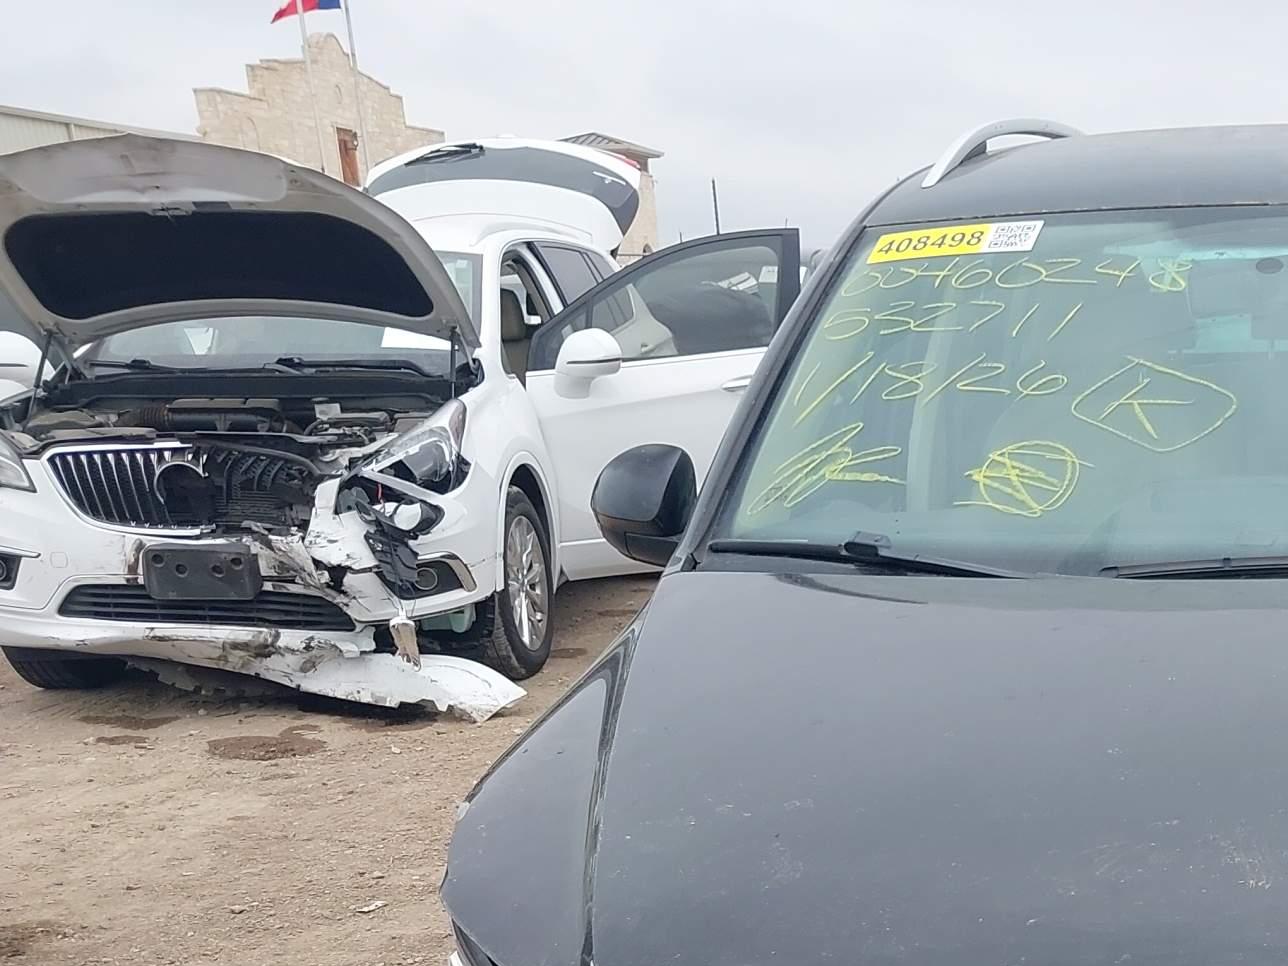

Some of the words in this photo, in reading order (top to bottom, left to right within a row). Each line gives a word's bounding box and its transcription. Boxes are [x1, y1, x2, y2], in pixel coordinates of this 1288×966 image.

[876, 229, 985, 257] 408498
[823, 300, 1084, 342] 532711
[792, 350, 1069, 428] 1/18/26
